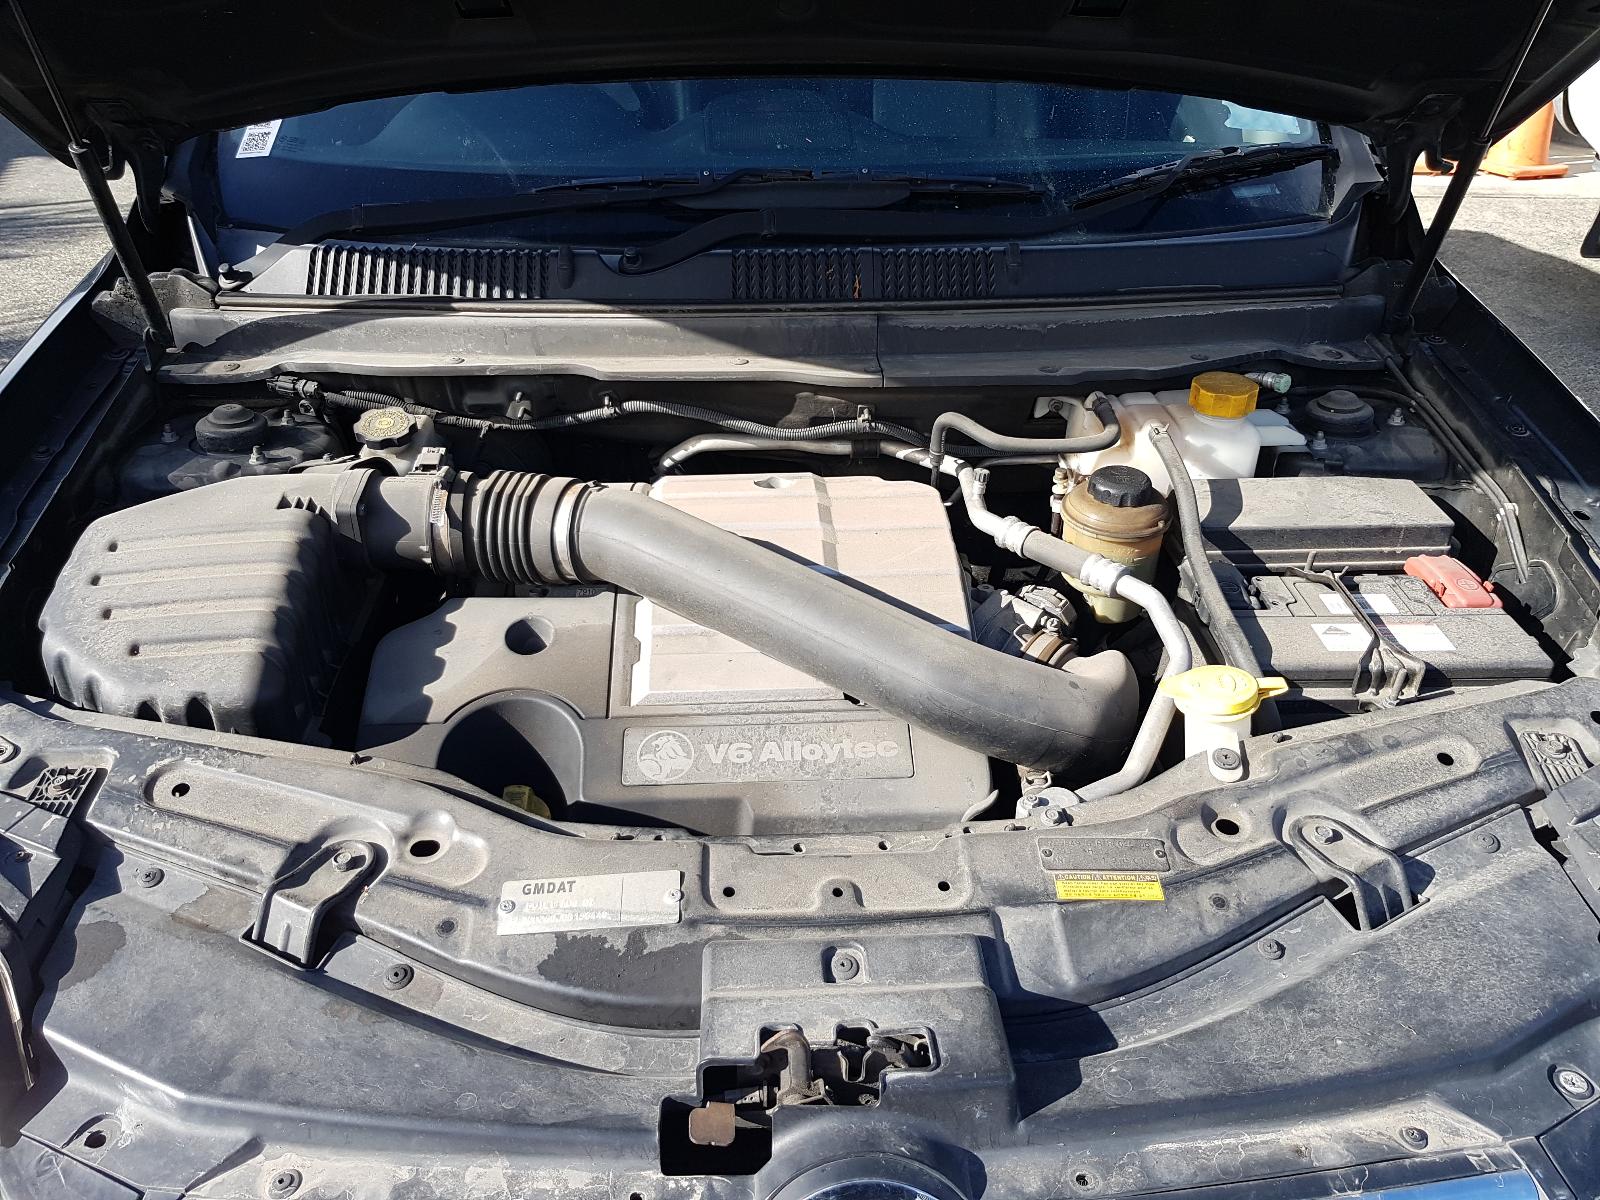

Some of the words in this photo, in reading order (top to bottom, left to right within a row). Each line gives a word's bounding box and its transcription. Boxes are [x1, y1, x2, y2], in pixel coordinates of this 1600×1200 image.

[703, 742, 753, 764] V6
[758, 738, 899, 764] Alloytec
[522, 880, 576, 896] GMDAT
